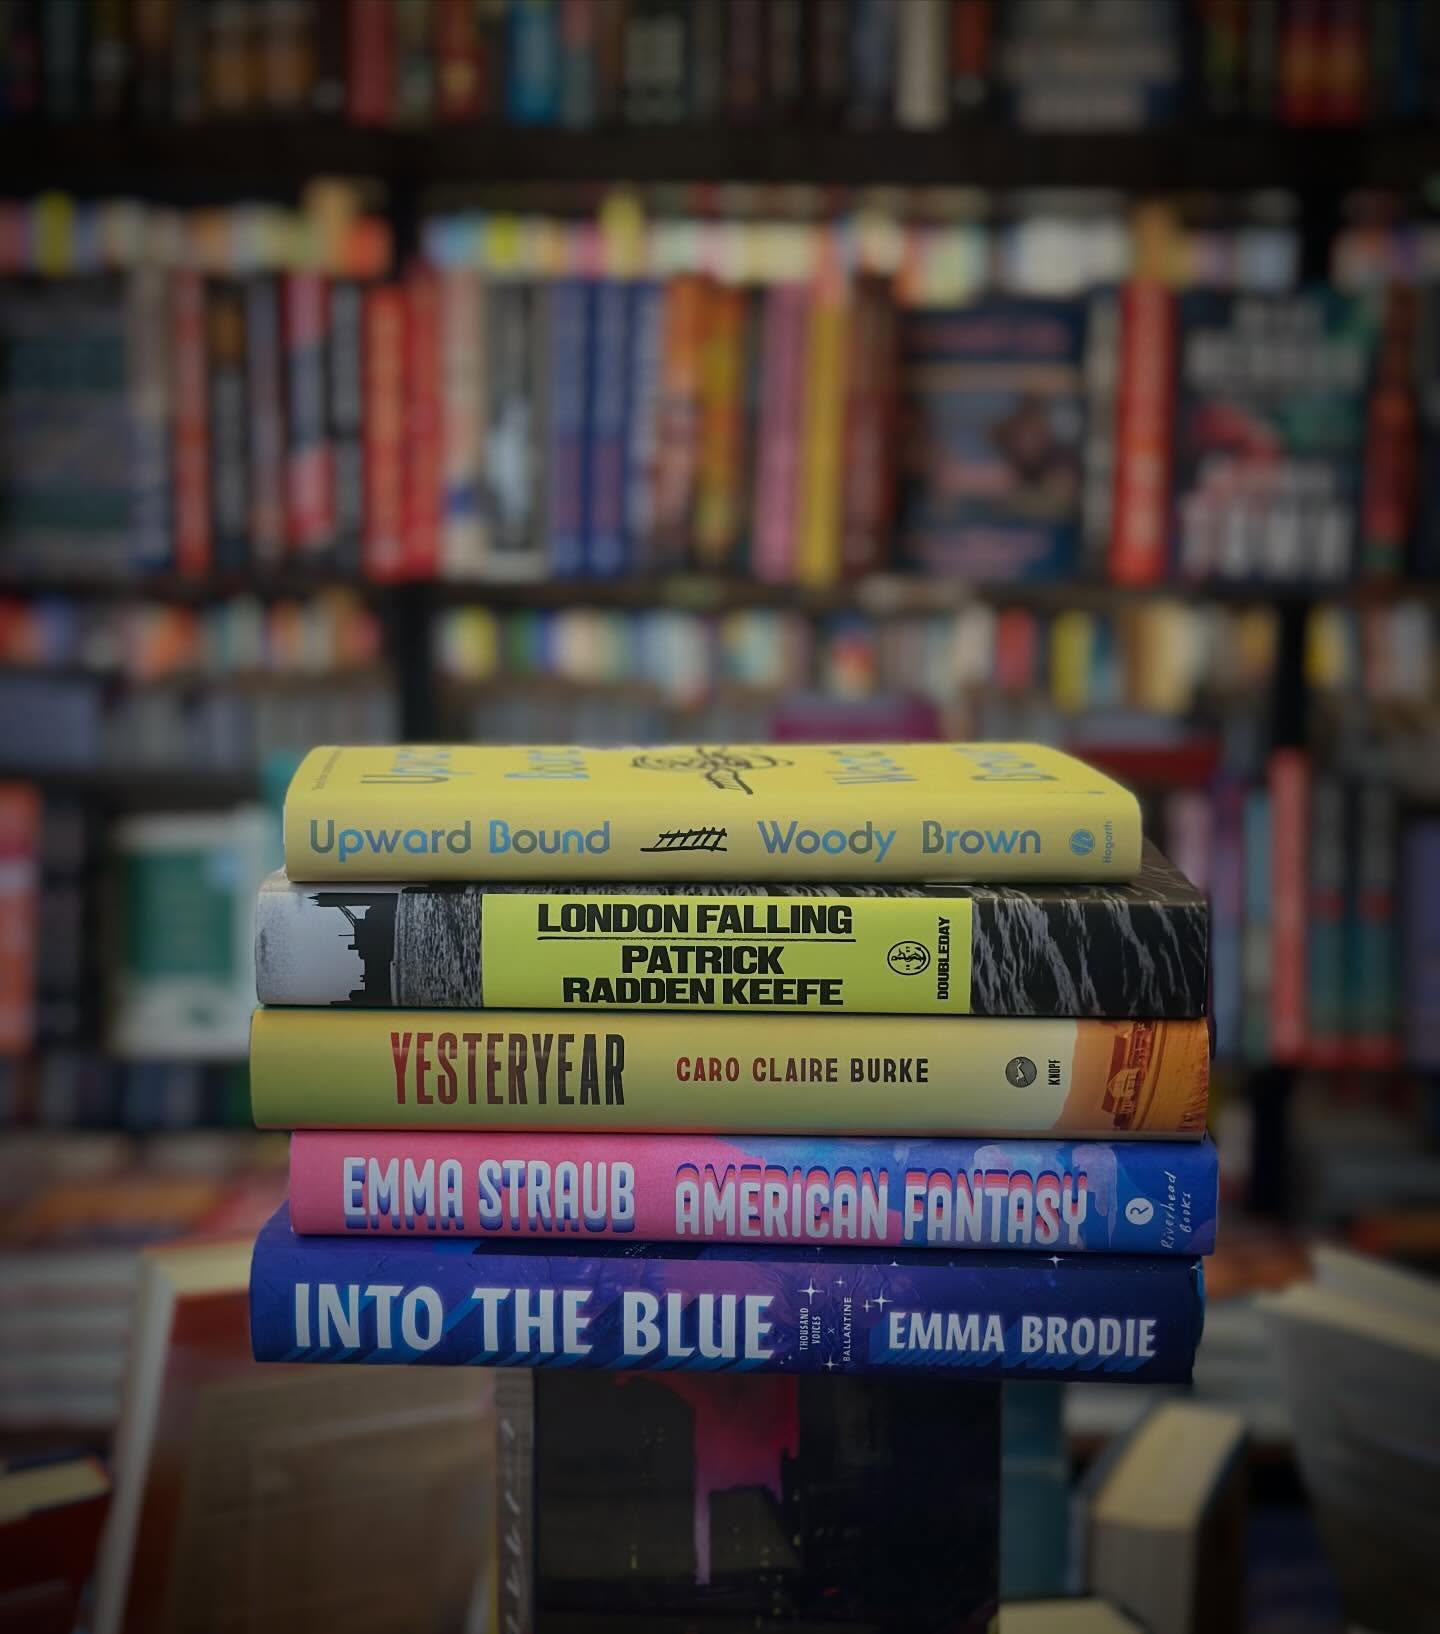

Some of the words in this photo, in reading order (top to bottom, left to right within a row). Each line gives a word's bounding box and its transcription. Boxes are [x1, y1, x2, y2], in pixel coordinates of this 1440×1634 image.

[310, 819, 472, 864] Upward
[488, 819, 611, 855] Bound
[756, 820, 897, 864] Woody
[922, 819, 1042, 855] Brown
[1102, 819, 1114, 866] Hogarth
[537, 903, 690, 934] LONDON
[696, 903, 853, 935] FALLING
[621, 945, 785, 976] PATRICK
[936, 916, 950, 1000] DOUBLEDAY
[562, 976, 715, 1005] RADDEN
[722, 977, 845, 1006] KEEFE
[390, 1031, 625, 1106] YESTERYEAR
[675, 1056, 741, 1083] CARO
[751, 1057, 839, 1084] CLAIRE
[849, 1057, 930, 1084] BURKE
[1047, 1059, 1062, 1086] KNOPF
[343, 1156, 465, 1231] EMMA
[477, 1158, 636, 1234] STRAUB
[675, 1163, 889, 1240] AMERICAN
[903, 1166, 1088, 1245] FANTASY
[1160, 1170, 1177, 1249] Riverhead
[294, 1282, 444, 1352] INTO
[470, 1287, 594, 1355] THE
[622, 1290, 775, 1360] BLUE
[799, 1306, 809, 1352] THOUSAND
[811, 1315, 821, 1345] VOICES
[842, 1296, 852, 1362] BALLANTINE
[888, 1311, 1005, 1354] EMMA
[1020, 1314, 1158, 1357] BRODIE
